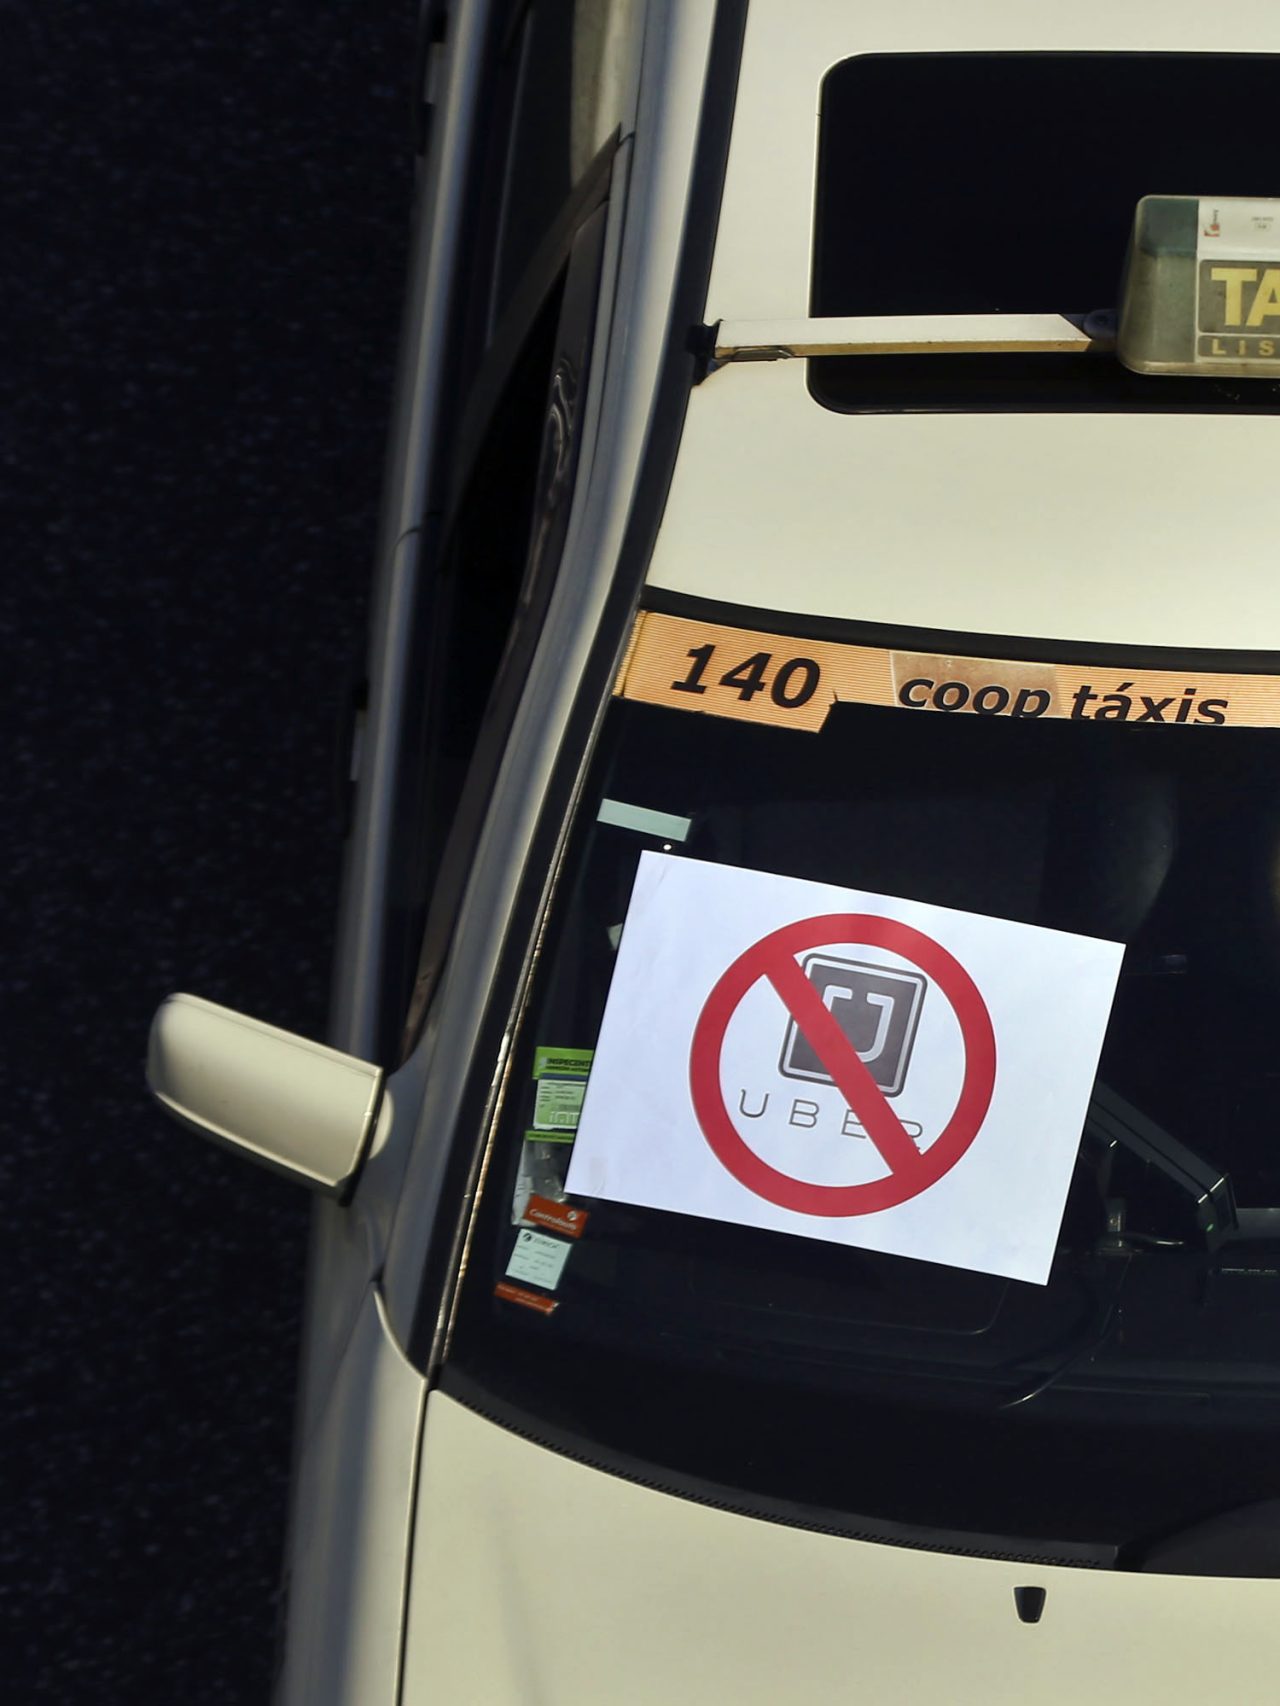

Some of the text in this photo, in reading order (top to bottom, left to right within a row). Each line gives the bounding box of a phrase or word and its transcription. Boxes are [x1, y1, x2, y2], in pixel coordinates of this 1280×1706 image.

[670, 643, 821, 709] 140
[898, 677, 1230, 725] coop táxis
